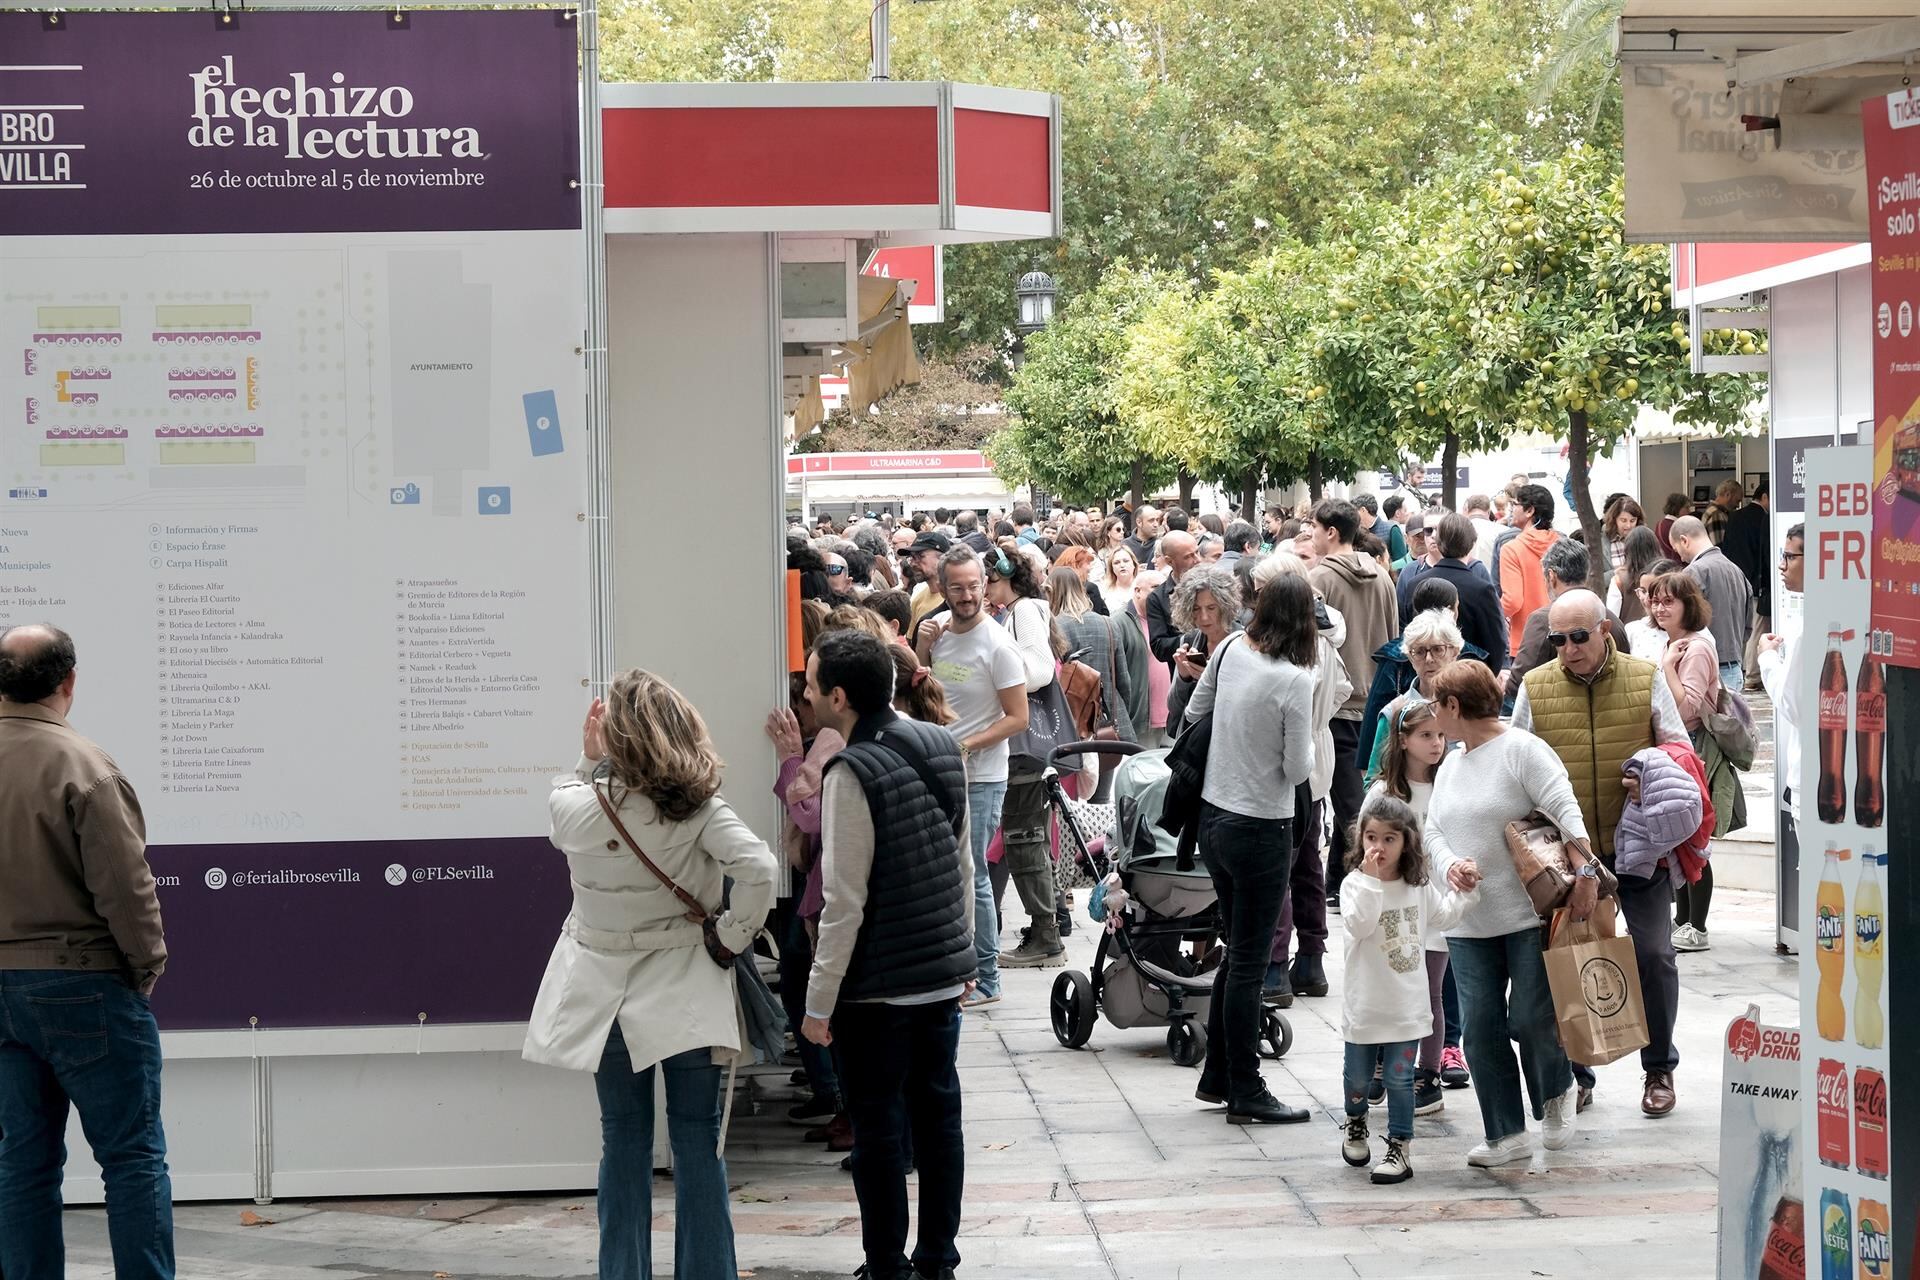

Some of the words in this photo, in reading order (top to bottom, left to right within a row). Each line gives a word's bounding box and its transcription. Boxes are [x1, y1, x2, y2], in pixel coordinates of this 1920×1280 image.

[203, 55, 236, 86] el
[189, 72, 414, 118] hechizo
[188, 114, 234, 147] de
[242, 114, 278, 147] la
[284, 114, 484, 159] lectura
[190, 171, 214, 189] 26
[218, 170, 241, 188] de
[246, 170, 316, 188] octubre
[321, 168, 338, 187] al
[342, 172, 354, 190] 5
[358, 170, 380, 187] de
[385, 168, 484, 188] noviembre
[1888, 208, 1914, 236] solo
[873, 264, 890, 278] 14
[870, 459, 923, 468] ULTRAMARINA
[1818, 482, 1874, 517] BEB
[1, 528, 29, 536] Nueva
[166, 525, 218, 534] Información
[228, 524, 258, 533] Firmas
[166, 542, 199, 553] Espacio
[201, 539, 226, 550] Érase
[1818, 530, 1873, 580] FR
[0, 561, 51, 571] Municipales
[166, 558, 192, 570] Carpa
[194, 558, 227, 569] Hispalit
[167, 582, 204, 590] Ediciones
[205, 582, 224, 590] Alfar
[200, 594, 208, 603] El
[209, 594, 240, 602] Cuartito
[407, 590, 435, 599] Gremio
[436, 590, 446, 598] de
[448, 590, 478, 598] Editores
[480, 590, 489, 598] de
[490, 590, 498, 598] la
[498, 589, 525, 600] Región
[18, 598, 36, 607] Hoja
[38, 597, 48, 605] de
[49, 597, 66, 605] Lata
[407, 600, 417, 608] de
[418, 600, 444, 608] Murcia
[168, 608, 176, 616] El
[178, 607, 200, 616] Paseo
[202, 607, 234, 615] Editorial
[408, 612, 440, 621] Bookolia
[449, 612, 470, 620] Liana
[472, 612, 504, 620] Editorial
[168, 620, 192, 628] Botica
[193, 620, 203, 628] de
[205, 620, 236, 628] Lectores
[244, 619, 265, 627] Alma
[449, 625, 485, 633] Ediciones
[200, 632, 231, 640] Infancia
[240, 631, 283, 640] Kalandraka
[168, 645, 177, 654] El
[210, 645, 228, 653] libro
[409, 650, 441, 658] Editorial
[442, 650, 472, 658] Cerbero
[480, 649, 511, 660] Vegueta
[170, 658, 203, 666] Editorial
[246, 657, 290, 665] Automática
[290, 656, 323, 664] Editorial
[409, 663, 436, 671] Namek
[445, 662, 476, 671] Readuck
[170, 671, 207, 679] Athenaica
[410, 675, 433, 683] Libros
[434, 675, 444, 683] de
[445, 675, 452, 683] la
[454, 674, 480, 683] Herida
[519, 674, 537, 682] Casa
[201, 682, 239, 693] Quilombo
[247, 682, 270, 690] AKAL
[410, 685, 442, 693] Editorial
[444, 684, 472, 692] Novalis
[481, 684, 511, 692] Entorno
[512, 683, 540, 692] Gráfico
[171, 696, 216, 704] Ultramarina
[410, 698, 427, 706] Tres
[428, 697, 466, 705] Hermanas
[203, 708, 212, 716] La
[214, 708, 234, 718] Maga
[472, 709, 501, 717] Cabaret
[503, 709, 533, 717] Voltaire
[209, 720, 234, 729] Parker
[411, 723, 430, 731] Libre
[171, 734, 183, 742] Jot
[185, 734, 207, 742] Down
[204, 746, 219, 754] Laie
[221, 745, 264, 754] Caixaforum
[204, 758, 225, 766] Entre
[226, 758, 251, 766] Líneas
[173, 771, 205, 780] Editorial
[207, 771, 241, 779] Premium
[204, 784, 214, 792] La
[215, 783, 239, 792] Nueva
[232, 868, 361, 887] @ferialibrosevilla
[412, 865, 495, 882] @FLSevilla
[154, 876, 181, 887] om
[1818, 915, 1842, 938] FANTA
[1856, 914, 1880, 935] FANTA
[1762, 1030, 1800, 1045] COLD
[1760, 1044, 1800, 1061] DRIN
[1731, 1082, 1759, 1097] TAKE
[1762, 1086, 1798, 1101] AWAY
[1824, 1231, 1849, 1251] NESTEA
